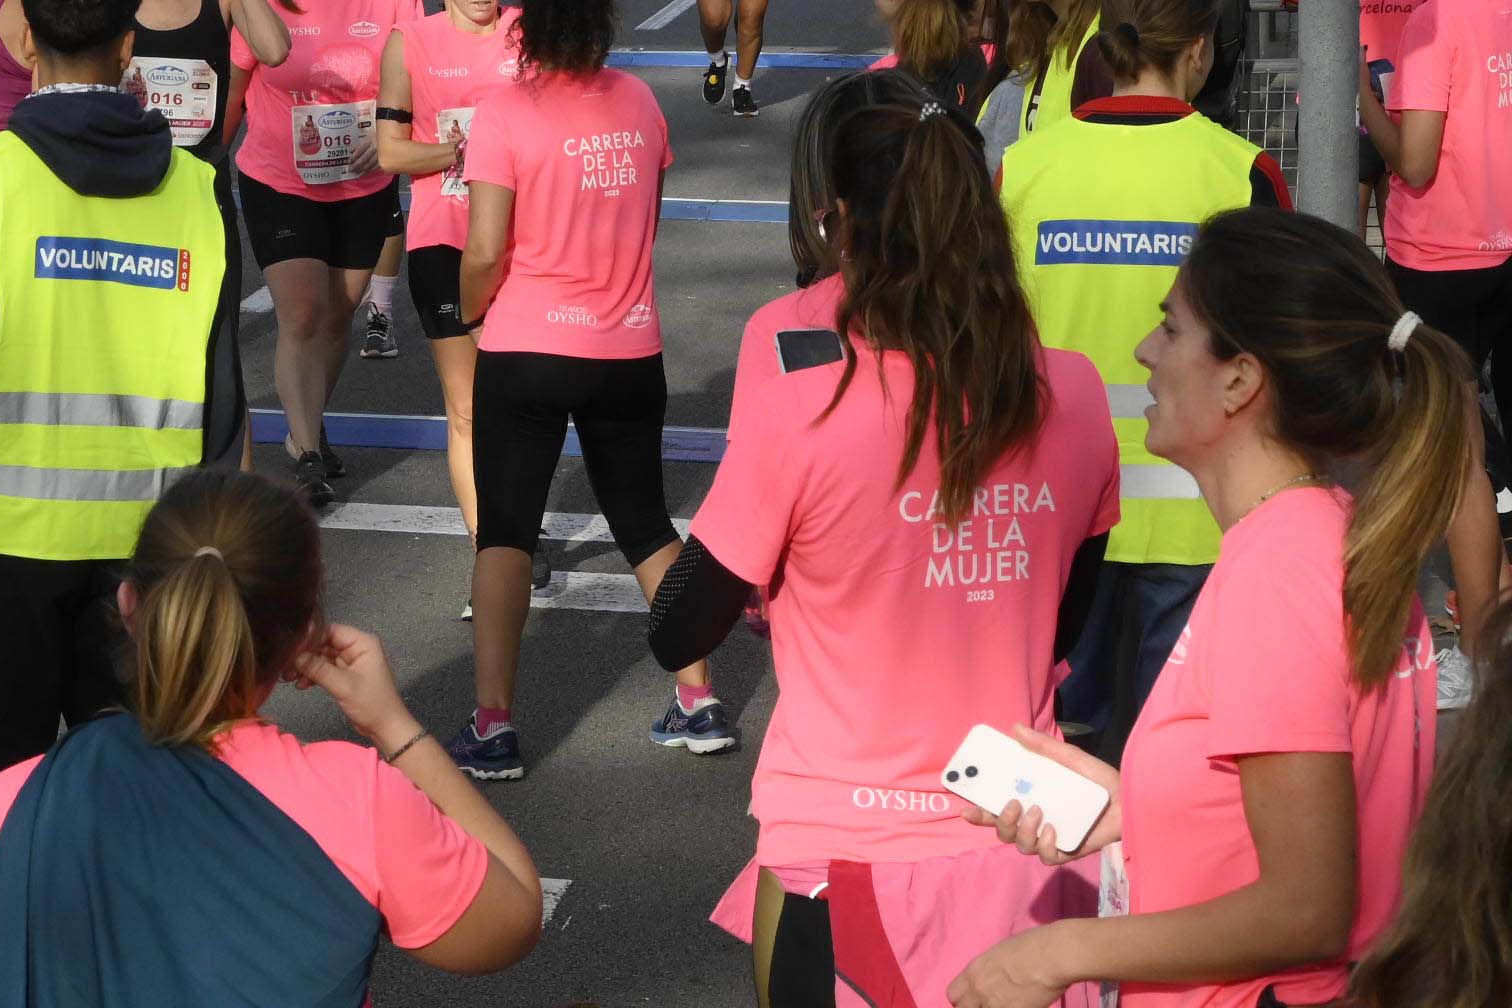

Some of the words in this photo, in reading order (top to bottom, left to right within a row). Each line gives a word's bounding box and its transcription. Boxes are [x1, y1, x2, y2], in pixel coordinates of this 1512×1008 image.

[1360, 0, 1412, 15] rcelona
[150, 92, 183, 106] 016
[324, 134, 352, 147] 016
[563, 129, 645, 157] CARRERA
[583, 152, 606, 172] DE
[612, 150, 634, 168] LA
[303, 170, 330, 179] OYSHO
[581, 167, 637, 192] MUJER
[604, 189, 620, 197] 2023
[1040, 232, 1195, 255] VOLUNTARIS
[39, 246, 175, 279] VOLUNTARIS
[547, 310, 598, 327] OYSHO
[898, 481, 1056, 524] CARERA
[932, 519, 973, 552] DE
[988, 518, 1026, 549] LA
[924, 550, 1030, 588] MUJER
[966, 589, 995, 603] 2023
[852, 785, 950, 814] OYSHO
